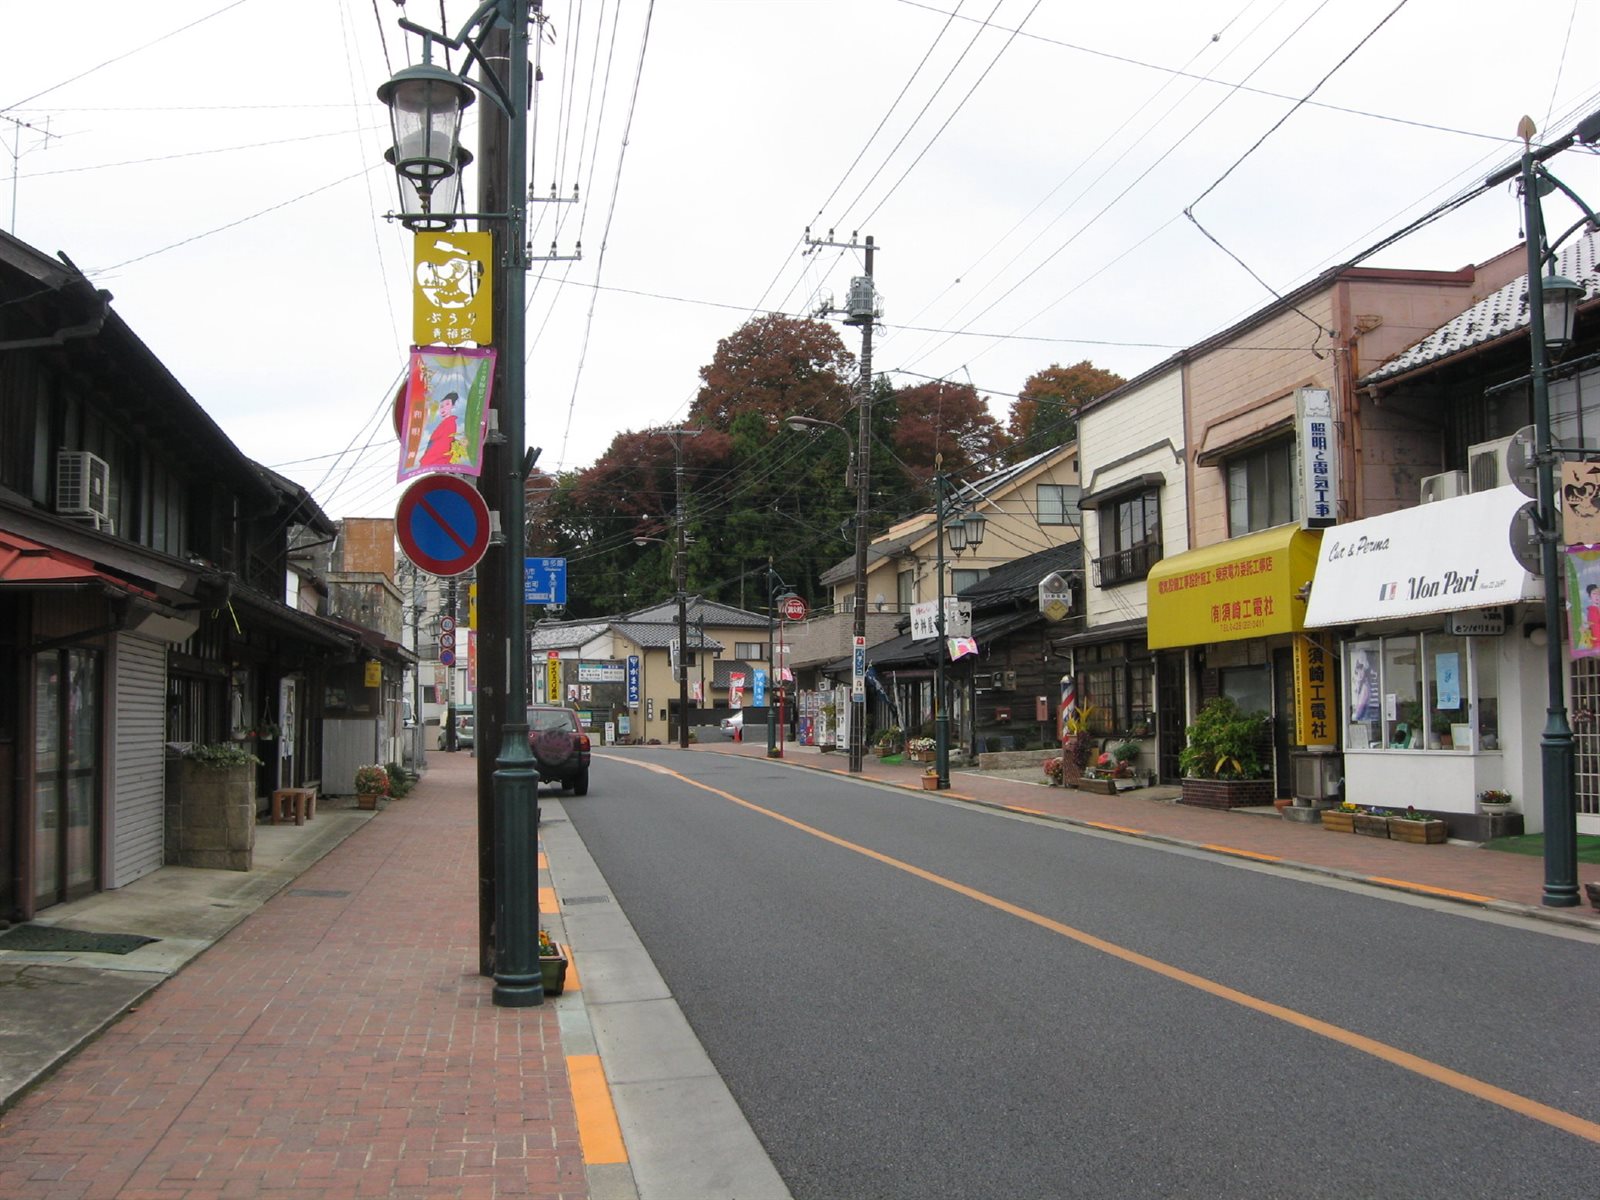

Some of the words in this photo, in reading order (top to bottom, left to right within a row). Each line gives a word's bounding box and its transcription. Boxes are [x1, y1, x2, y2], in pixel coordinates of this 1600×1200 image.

[1311, 422, 1330, 518] 照明と電気工事
[1328, 541, 1346, 562] Cut
[1406, 576, 1441, 600] Mon
[1442, 568, 1479, 595] Pari
